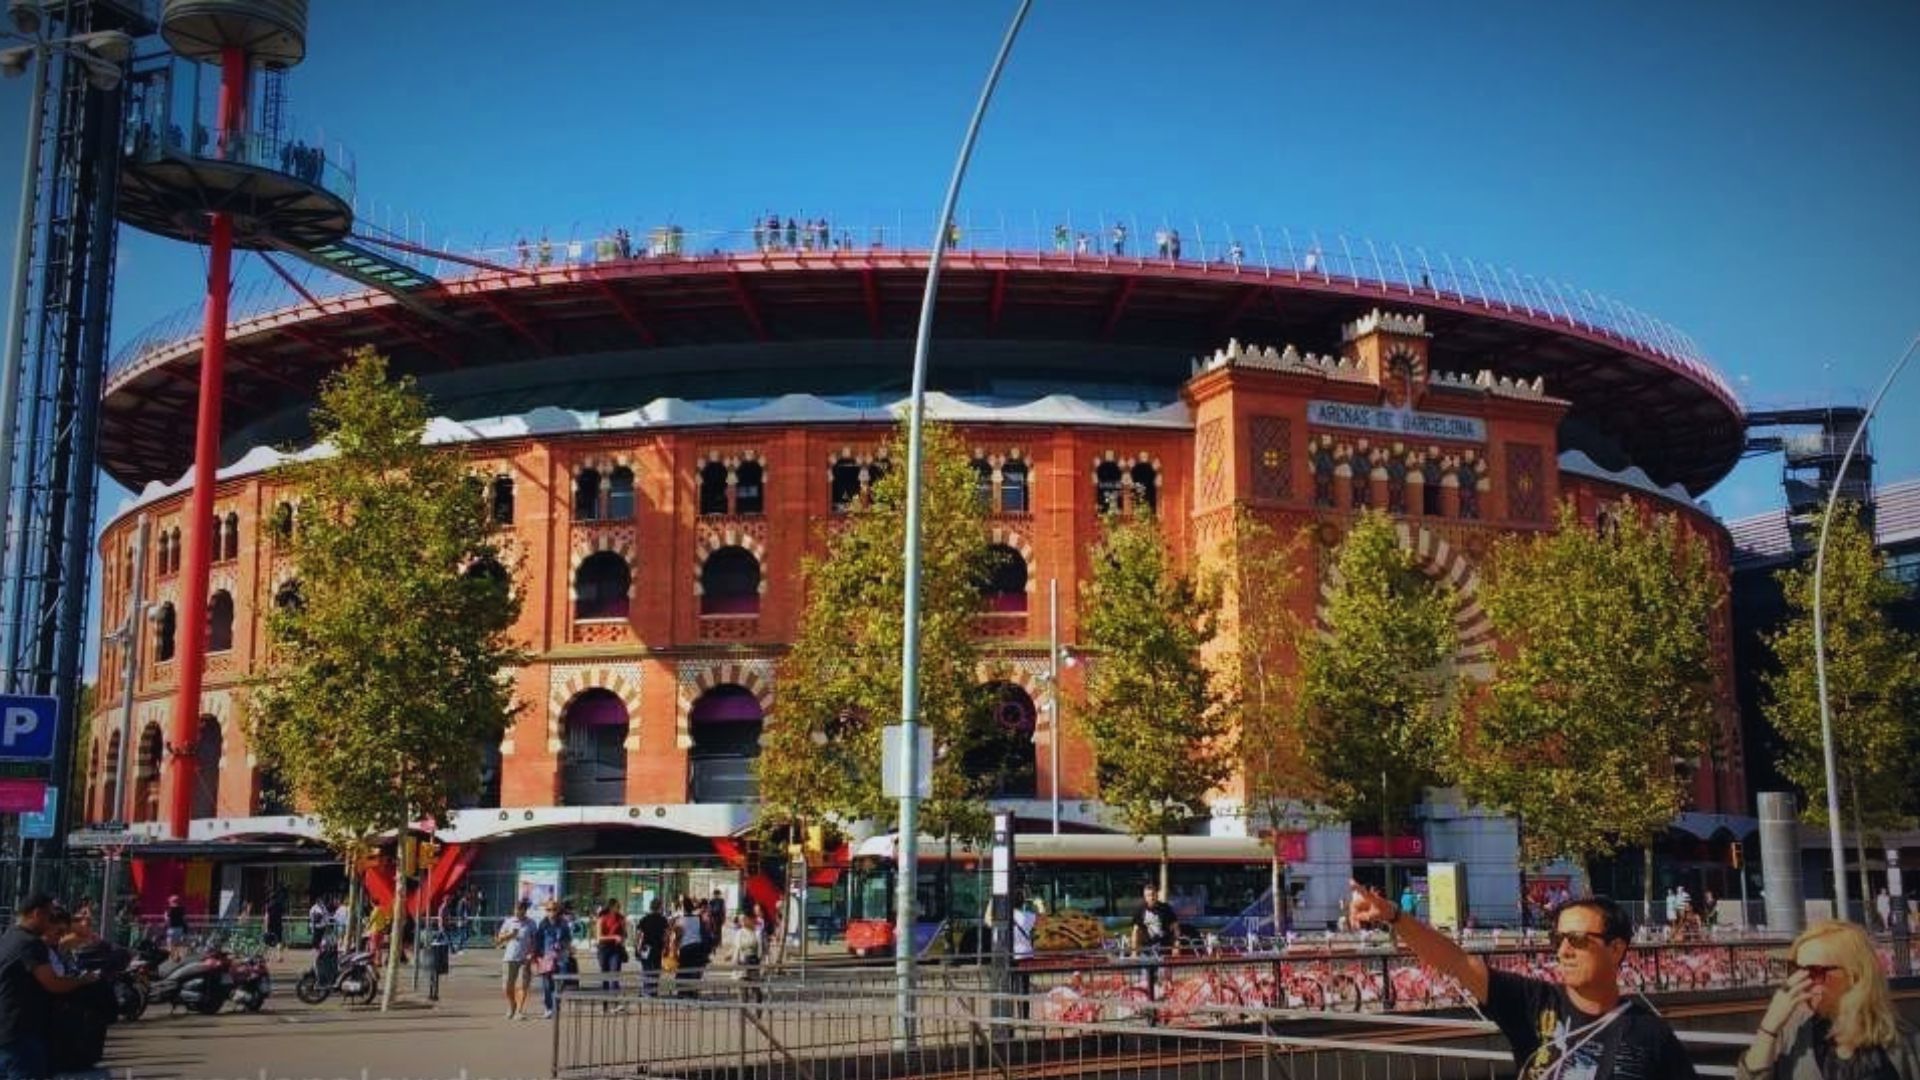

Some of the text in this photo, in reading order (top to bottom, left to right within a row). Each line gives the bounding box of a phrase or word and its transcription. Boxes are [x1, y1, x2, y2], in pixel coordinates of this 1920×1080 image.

[1318, 404, 1475, 437] ARENAS DE BARCELONA
[3, 706, 39, 746] P
